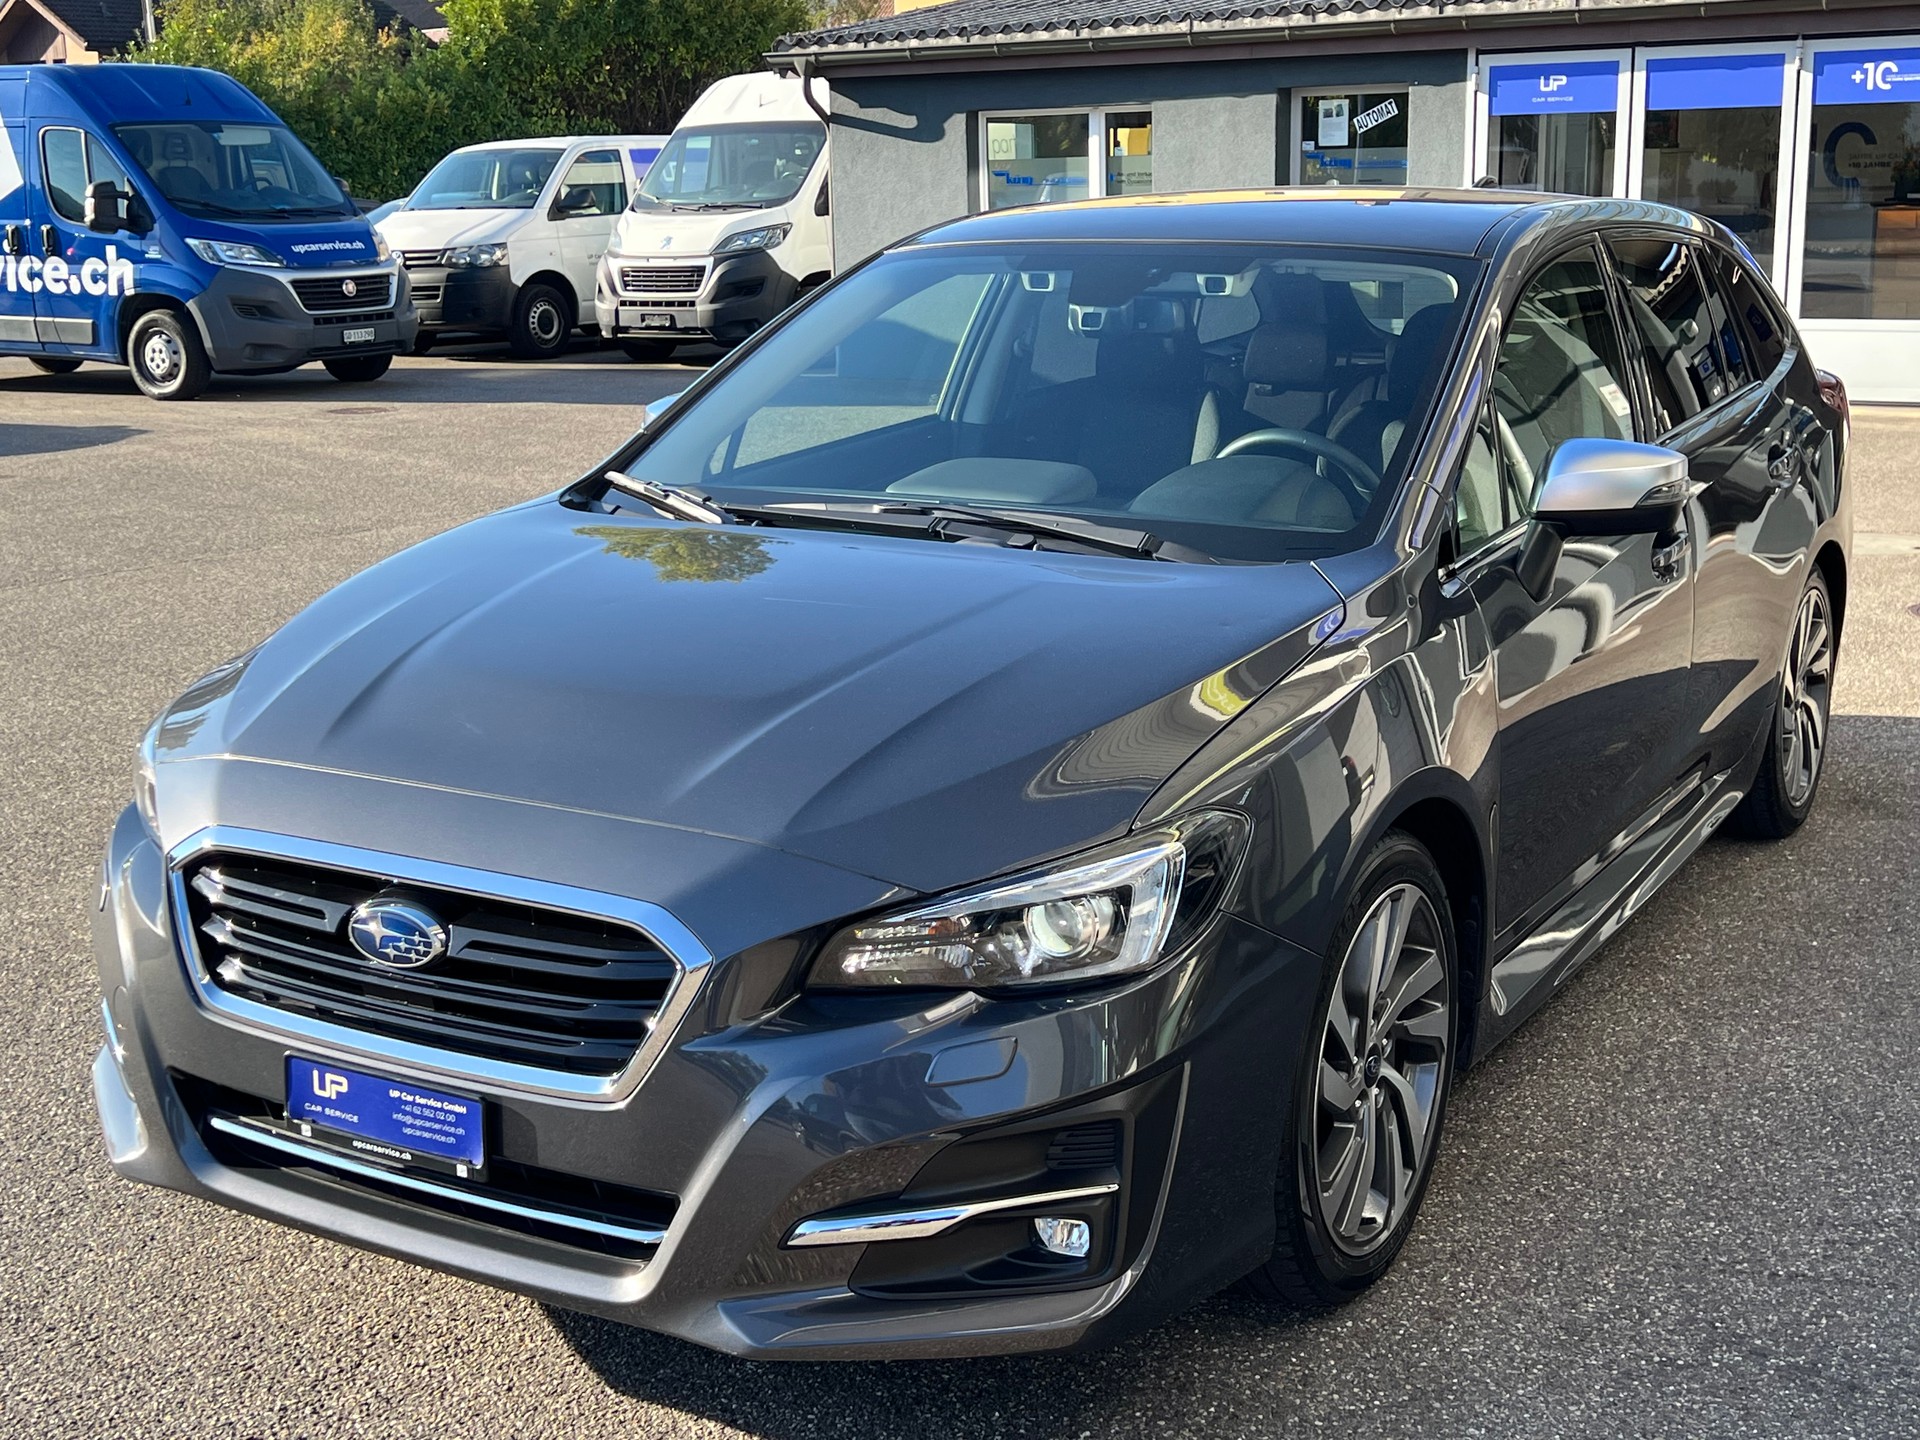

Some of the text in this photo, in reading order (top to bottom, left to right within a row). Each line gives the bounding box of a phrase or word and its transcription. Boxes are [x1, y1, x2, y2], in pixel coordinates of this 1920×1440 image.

[1540, 75, 1567, 91] UP
[1355, 100, 1397, 132] AUTOMAT
[291, 240, 366, 254] upcarservice.ch
[312, 1069, 348, 1100] UP
[388, 1088, 467, 1115] UP Car Service GmbH
[304, 1102, 359, 1123] CAR SERVICE
[401, 1104, 413, 1112] +41
[412, 1106, 422, 1115] 62
[435, 1111, 445, 1120] 02
[445, 1113, 456, 1123] 00
[392, 1111, 466, 1136] info@upcarservice.ch
[402, 1126, 457, 1144] upcarservice.ch
[352, 1139, 412, 1161] upcarservice.ch
